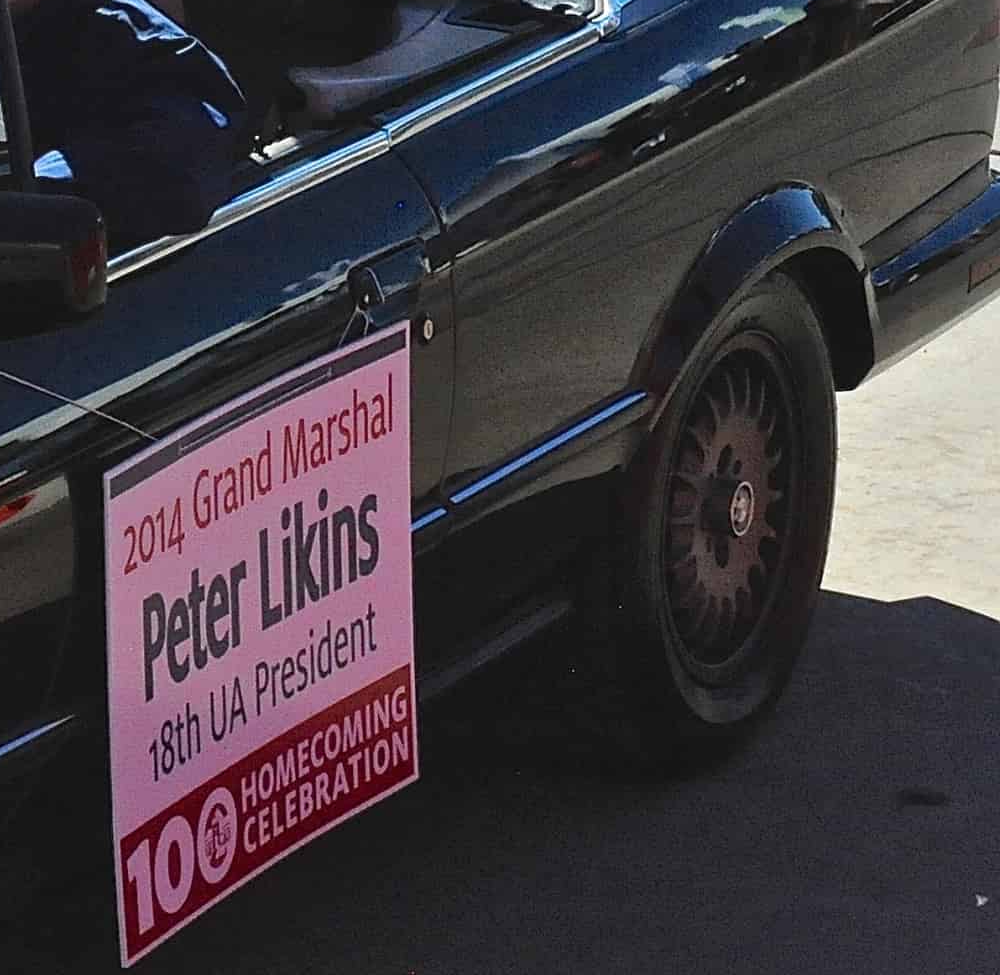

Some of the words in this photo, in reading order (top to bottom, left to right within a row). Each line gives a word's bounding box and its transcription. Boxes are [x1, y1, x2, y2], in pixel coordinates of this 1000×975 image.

[123, 497, 185, 575] 2014
[193, 430, 272, 529] Grand
[282, 372, 393, 484] Marshal
[142, 559, 247, 703] Peter
[258, 488, 380, 631] Likins
[149, 702, 201, 782] 18th
[209, 676, 247, 742] UA
[254, 602, 377, 716] President
[240, 685, 408, 813] HOMECOMING
[126, 786, 238, 936] 100
[242, 726, 409, 854] CELEBRATION
